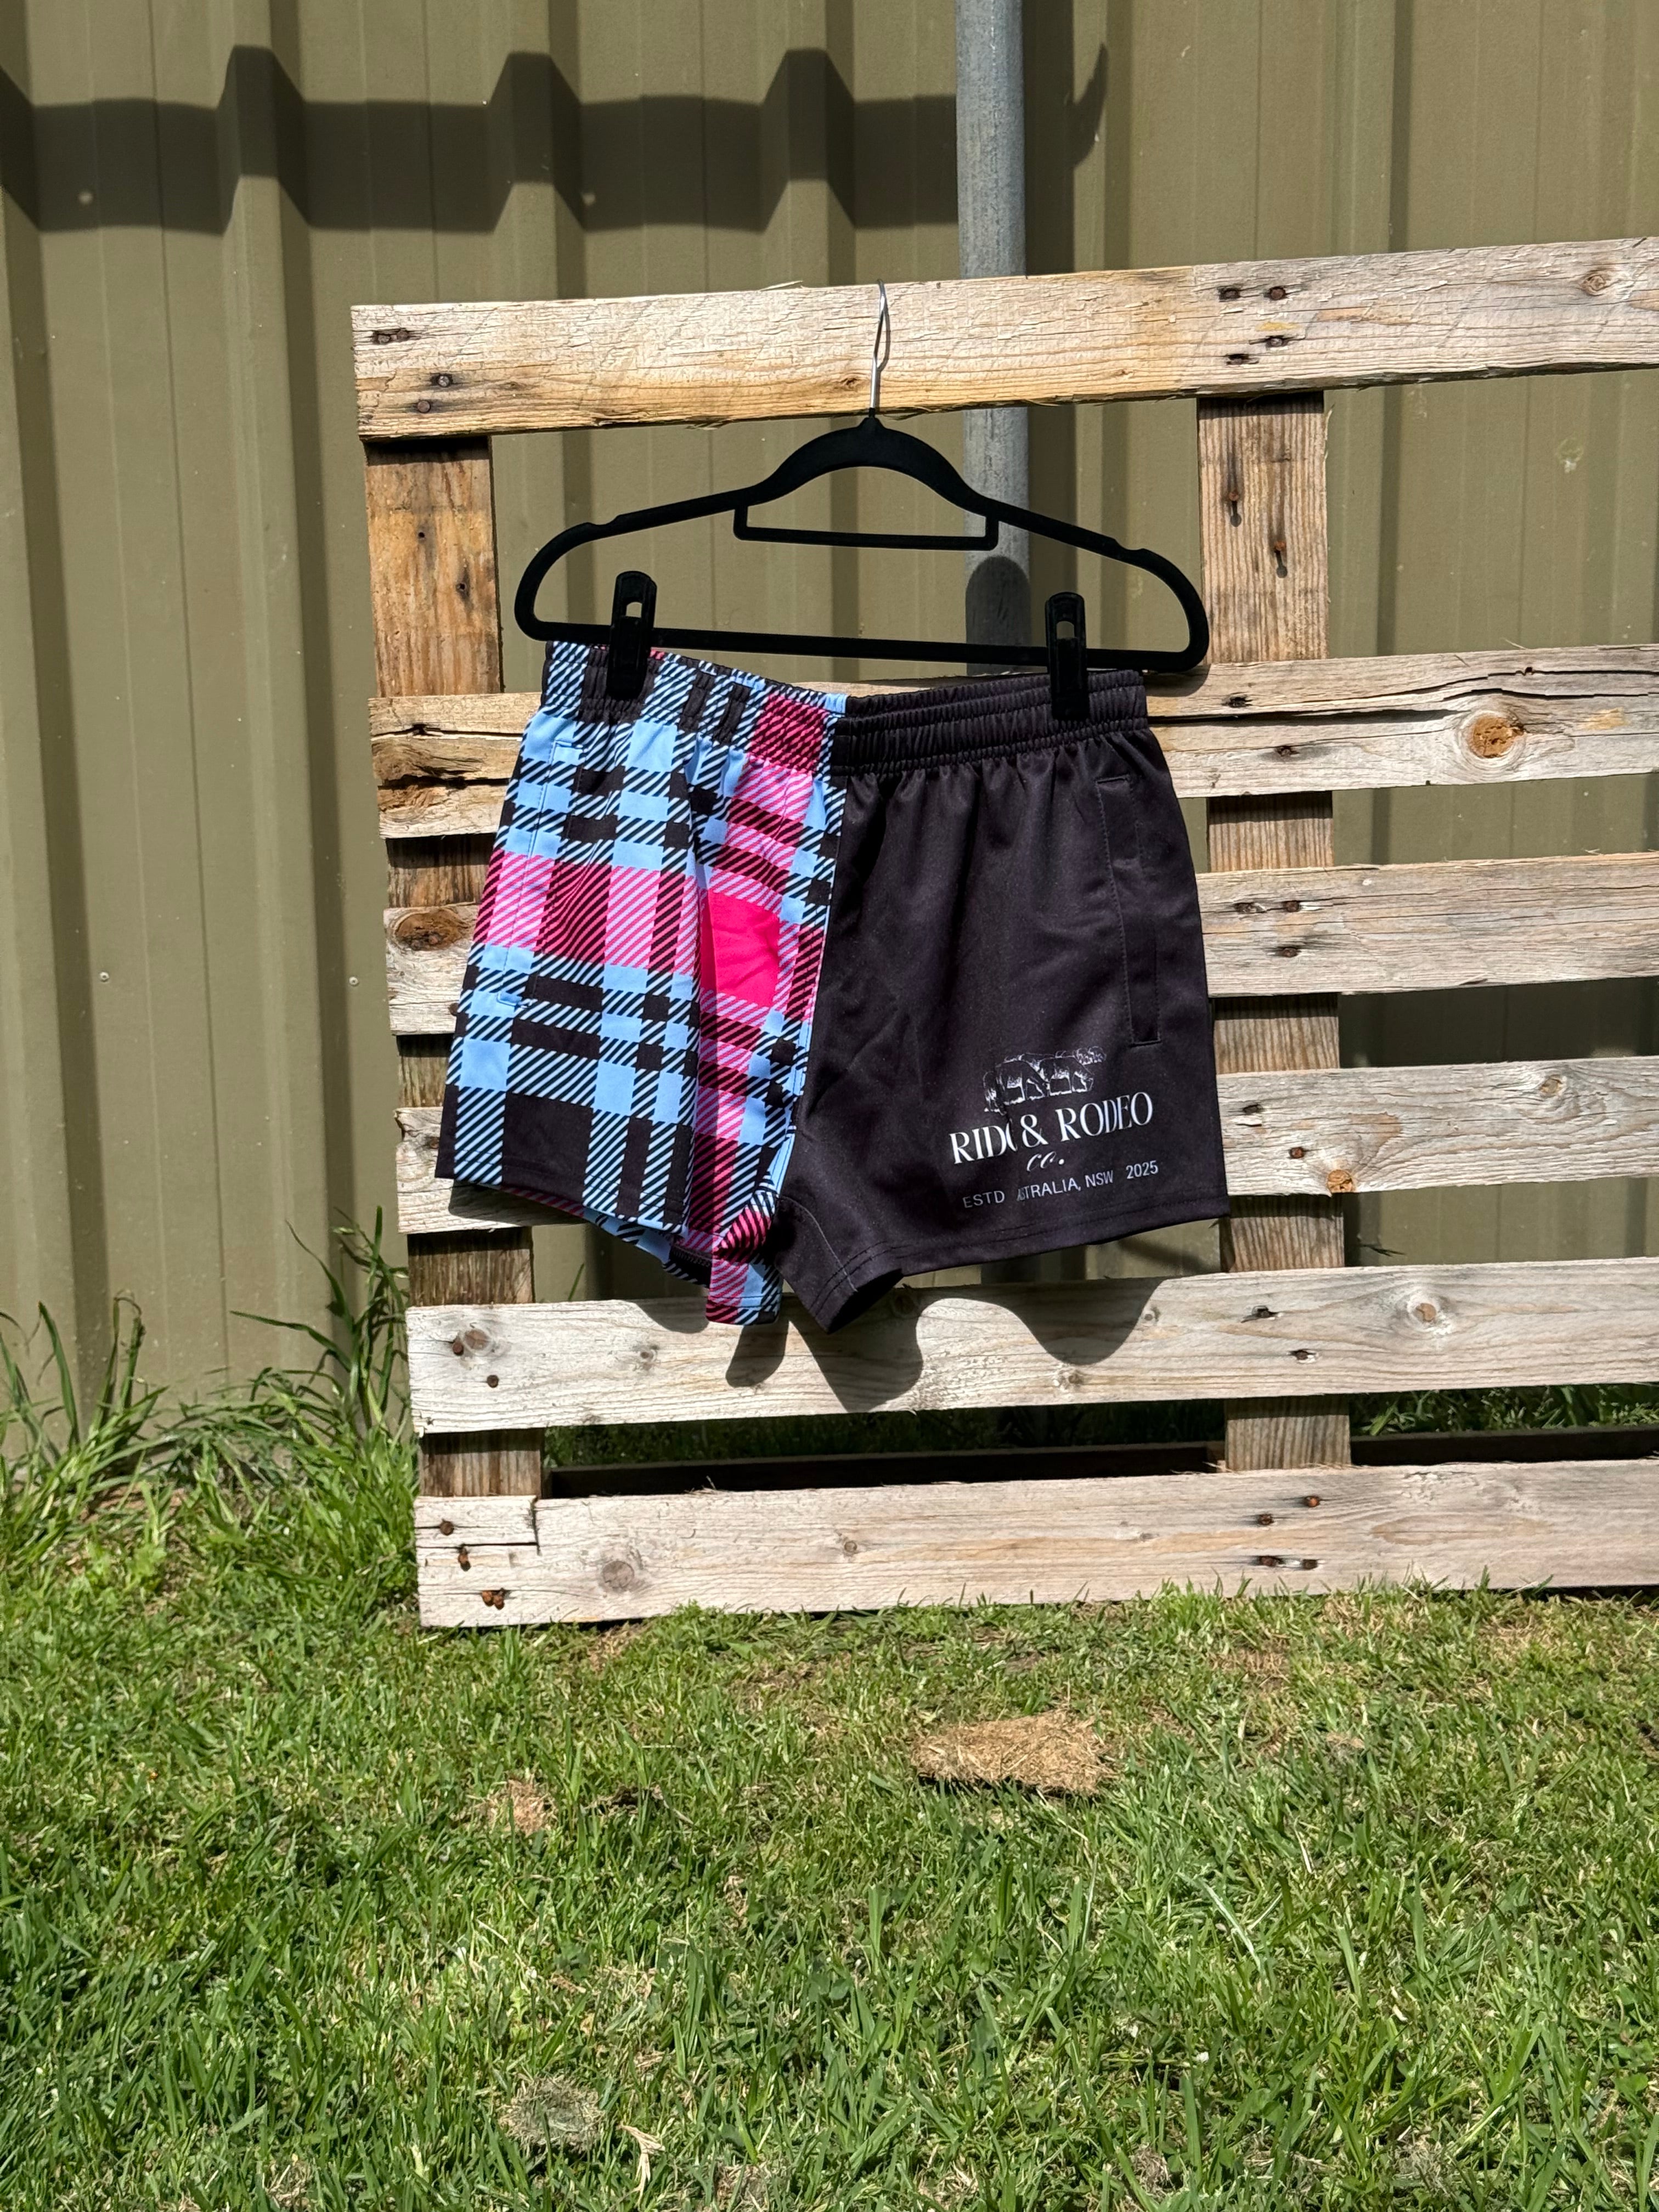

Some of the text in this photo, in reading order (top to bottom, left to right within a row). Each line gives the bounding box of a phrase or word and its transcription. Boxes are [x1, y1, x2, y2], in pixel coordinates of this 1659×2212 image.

[1020, 1114, 1049, 1148] &
[1055, 1092, 1153, 1142] RODEO
[962, 1190, 1005, 1209] ESTD
[1085, 1170, 1114, 1188] NSW
[1125, 1160, 1159, 1180] 2025
